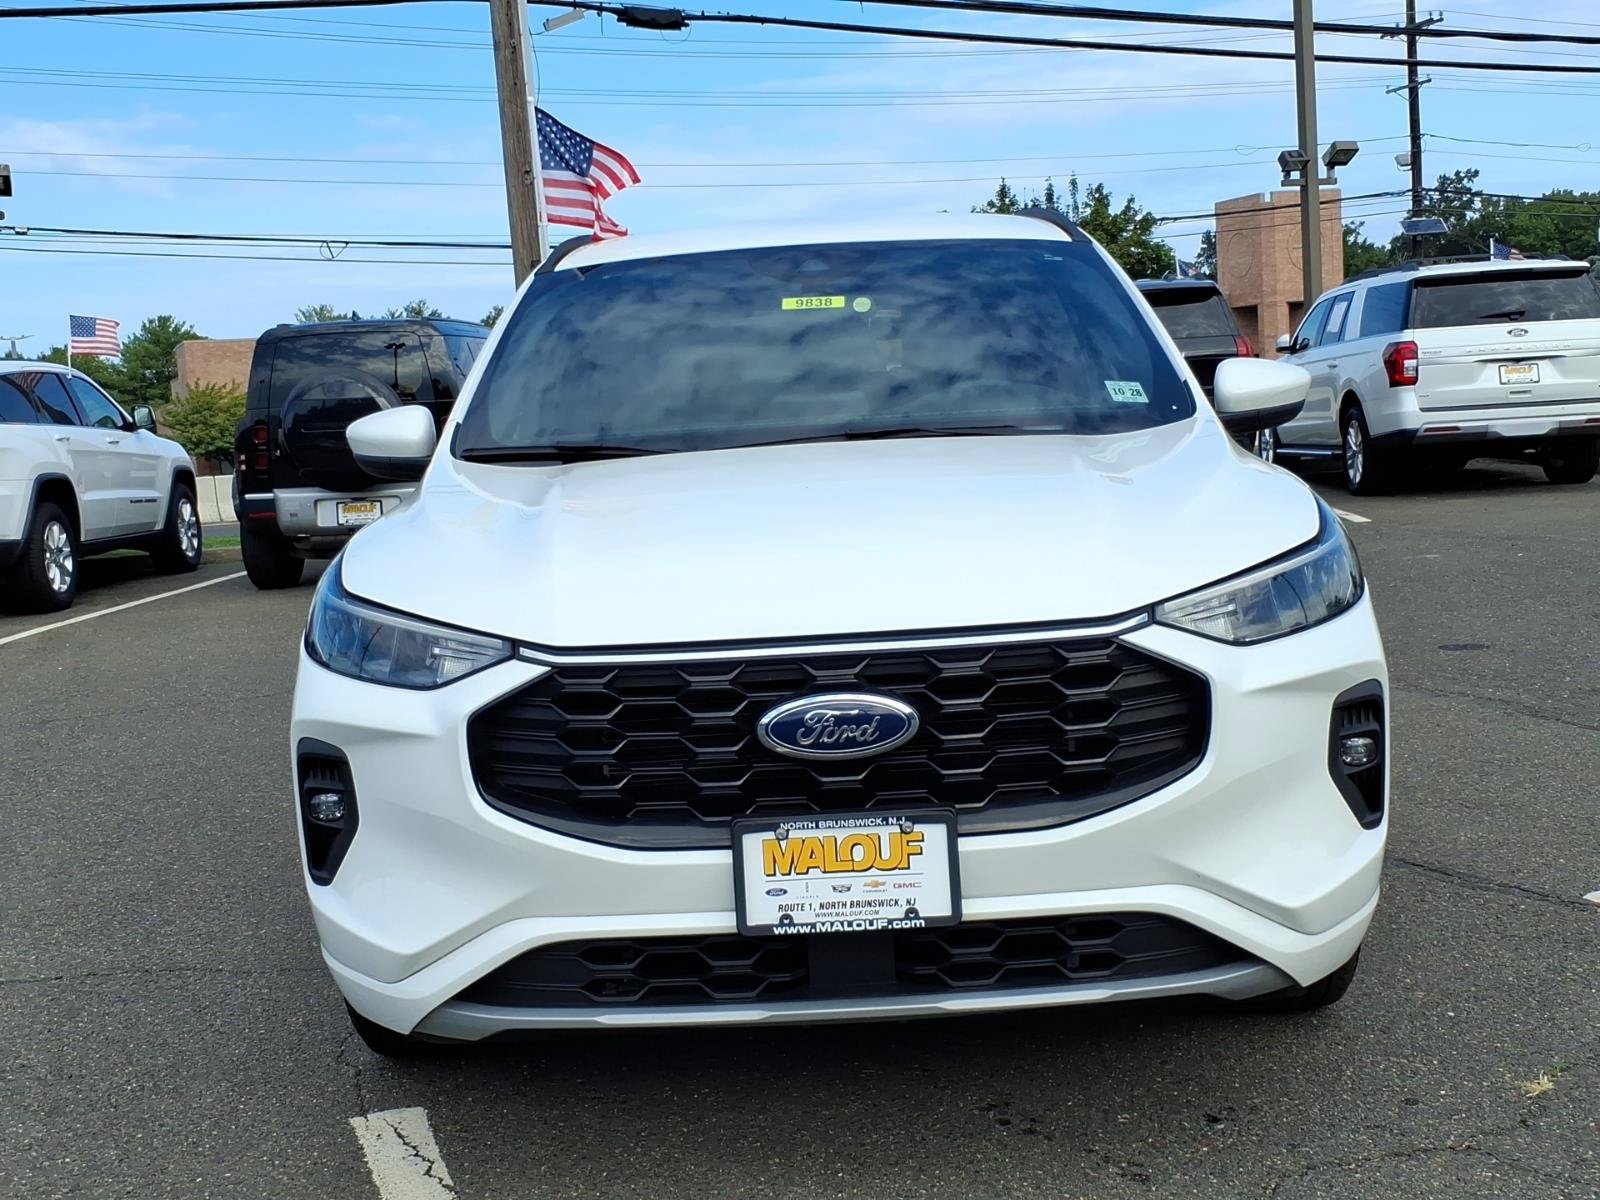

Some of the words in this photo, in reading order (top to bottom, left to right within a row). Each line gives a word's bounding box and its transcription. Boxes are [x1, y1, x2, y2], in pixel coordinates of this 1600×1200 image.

[795, 297, 833, 308] 9838
[1112, 388, 1125, 396] 10
[1128, 388, 1142, 397] 28
[796, 709, 881, 745] Ford
[780, 821, 816, 830] NORTH
[762, 831, 924, 877] MALOUF
[893, 881, 922, 889] GMC
[778, 902, 806, 912] ROUTE
[808, 902, 816, 912] 1,
[819, 900, 847, 910] NORTH
[849, 898, 903, 909] BRUNSWICK,
[905, 897, 916, 907] NJ
[814, 910, 880, 918] WWW.MALOUF.COM
[773, 918, 925, 935] www.MALOUF.com
